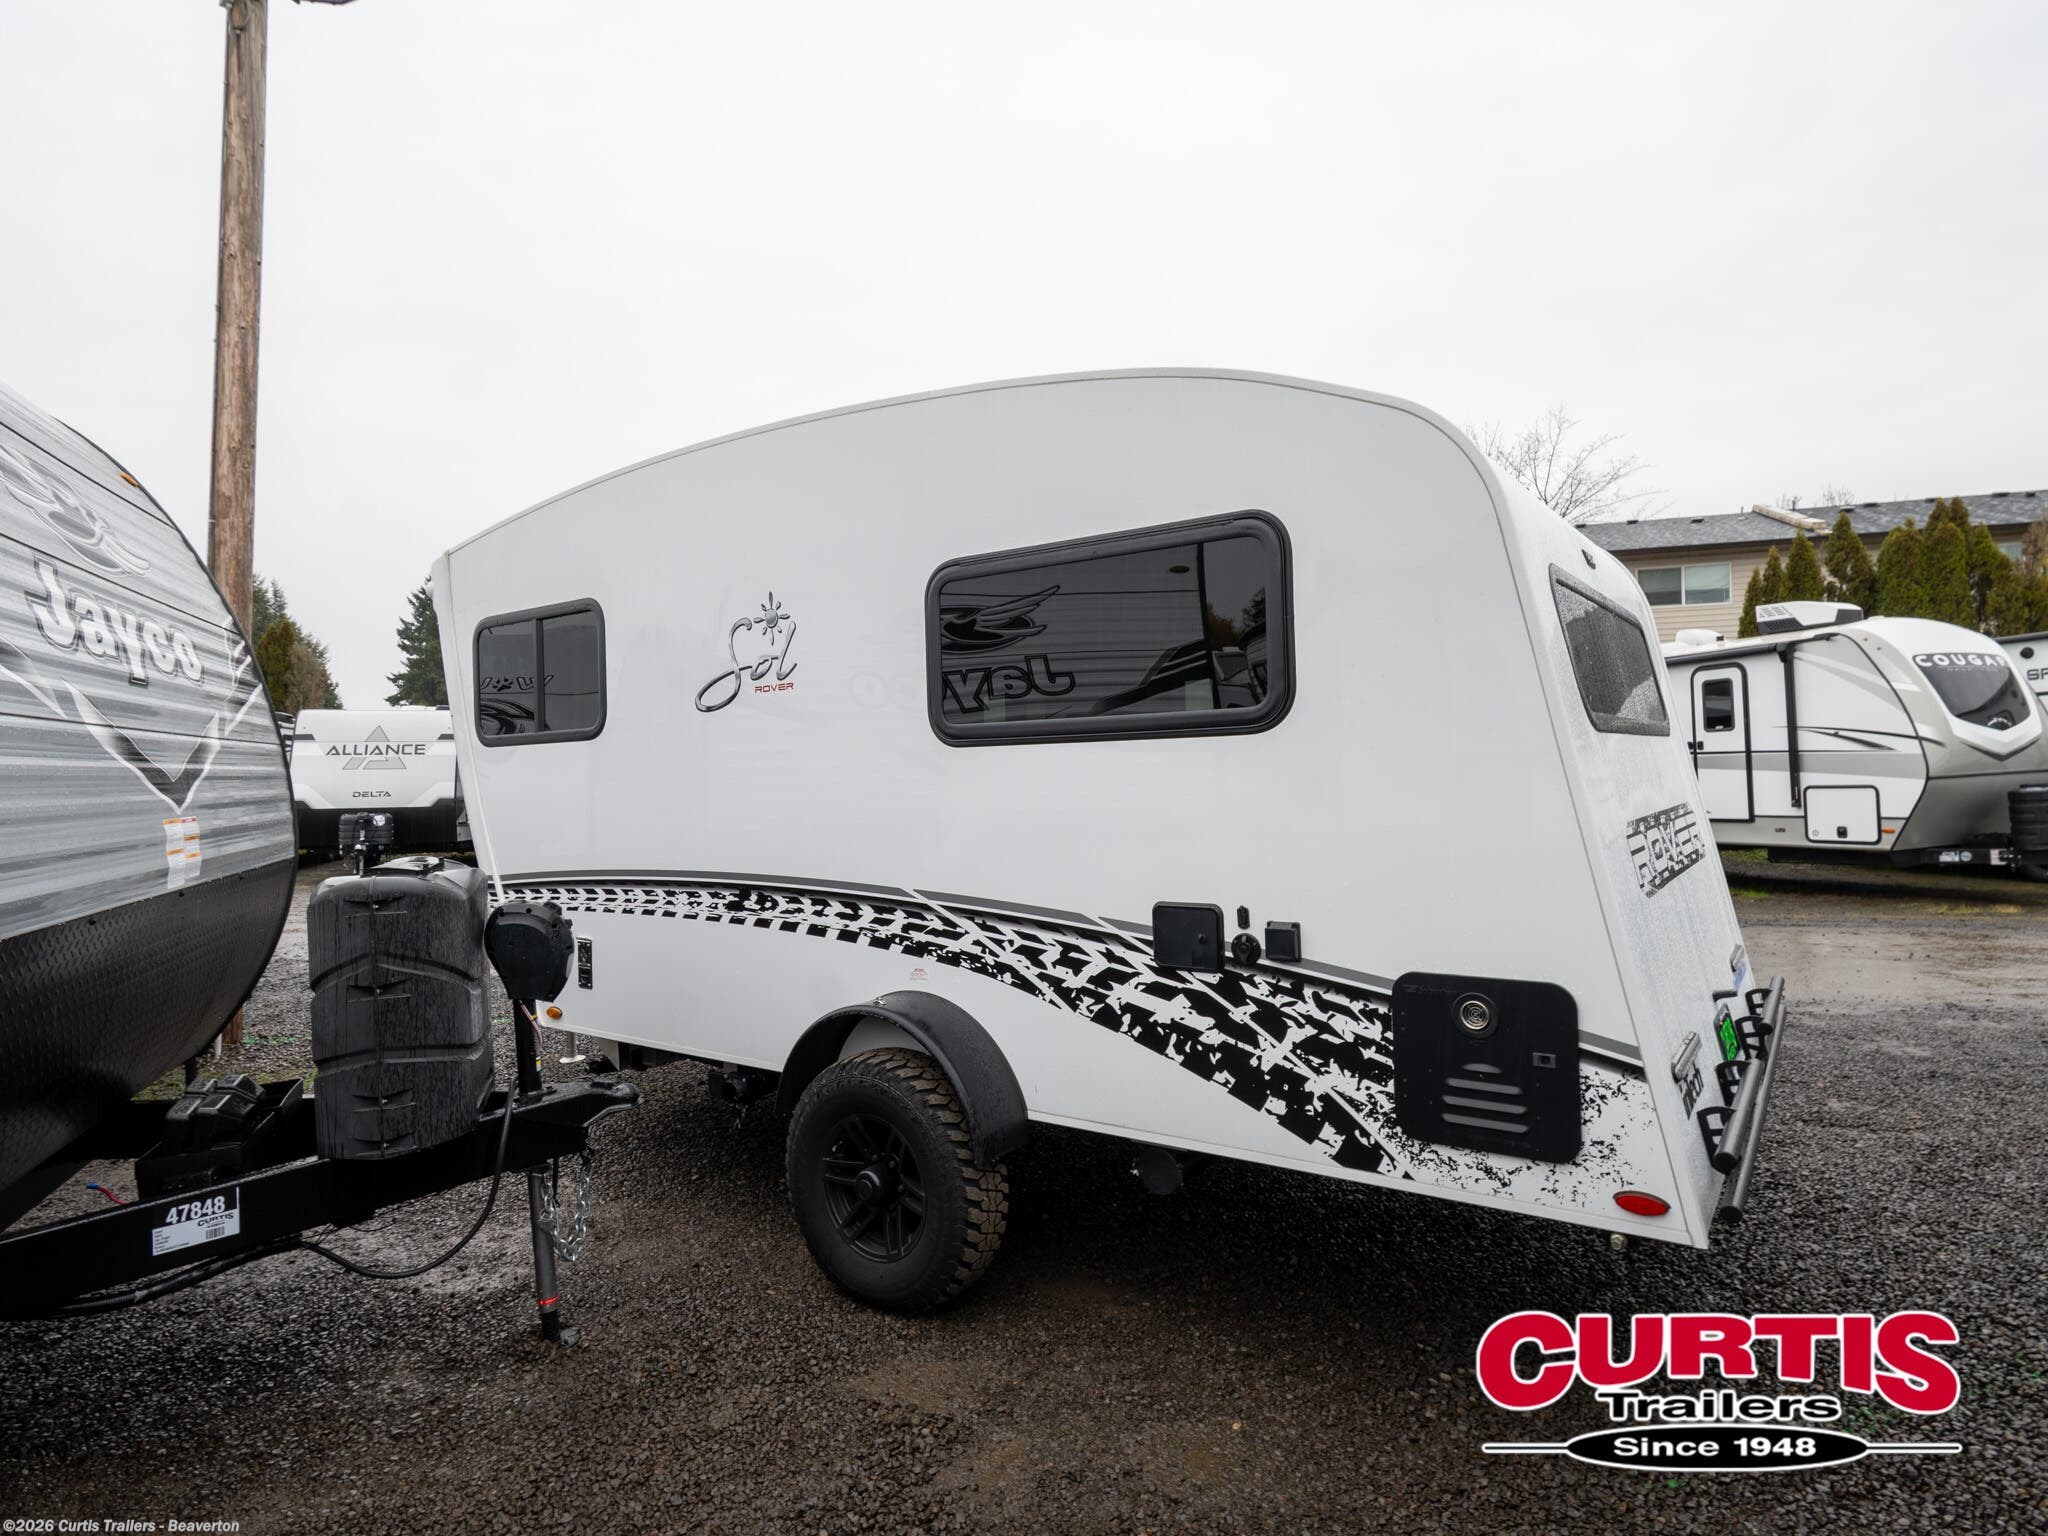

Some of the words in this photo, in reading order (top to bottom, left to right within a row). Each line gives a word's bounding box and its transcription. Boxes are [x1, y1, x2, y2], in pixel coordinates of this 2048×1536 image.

[24, 554, 205, 688] Jayco
[695, 617, 797, 712] Sol
[754, 682, 794, 693] ROVER
[326, 744, 426, 756] ALLIANCE
[166, 1196, 226, 1225] 47848
[197, 1212, 235, 1228] CURTIS
